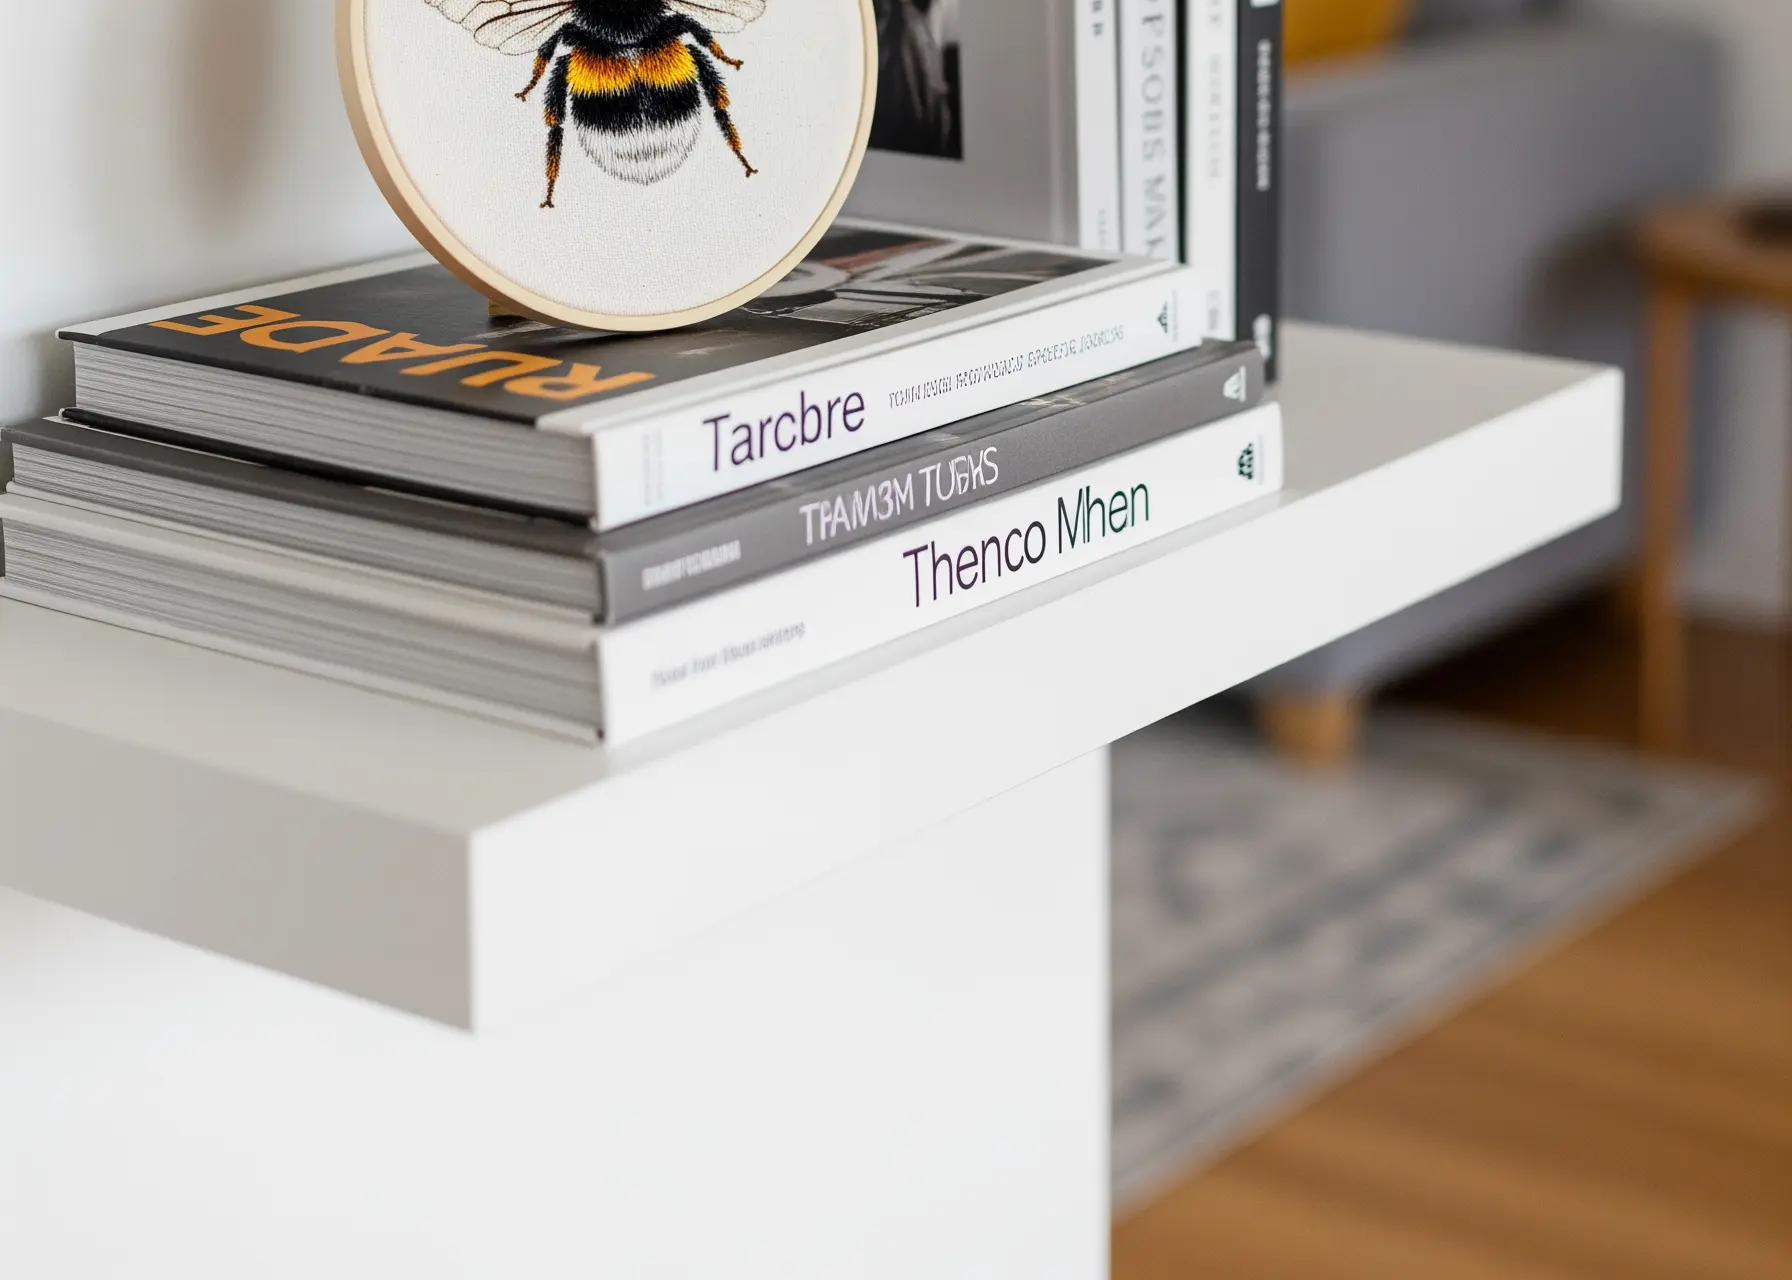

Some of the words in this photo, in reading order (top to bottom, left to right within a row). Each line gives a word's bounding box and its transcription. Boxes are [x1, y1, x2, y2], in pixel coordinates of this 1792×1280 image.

[148, 304, 657, 400] RUADE
[703, 390, 865, 472] Tarcbre
[902, 520, 1046, 608] Thenco
